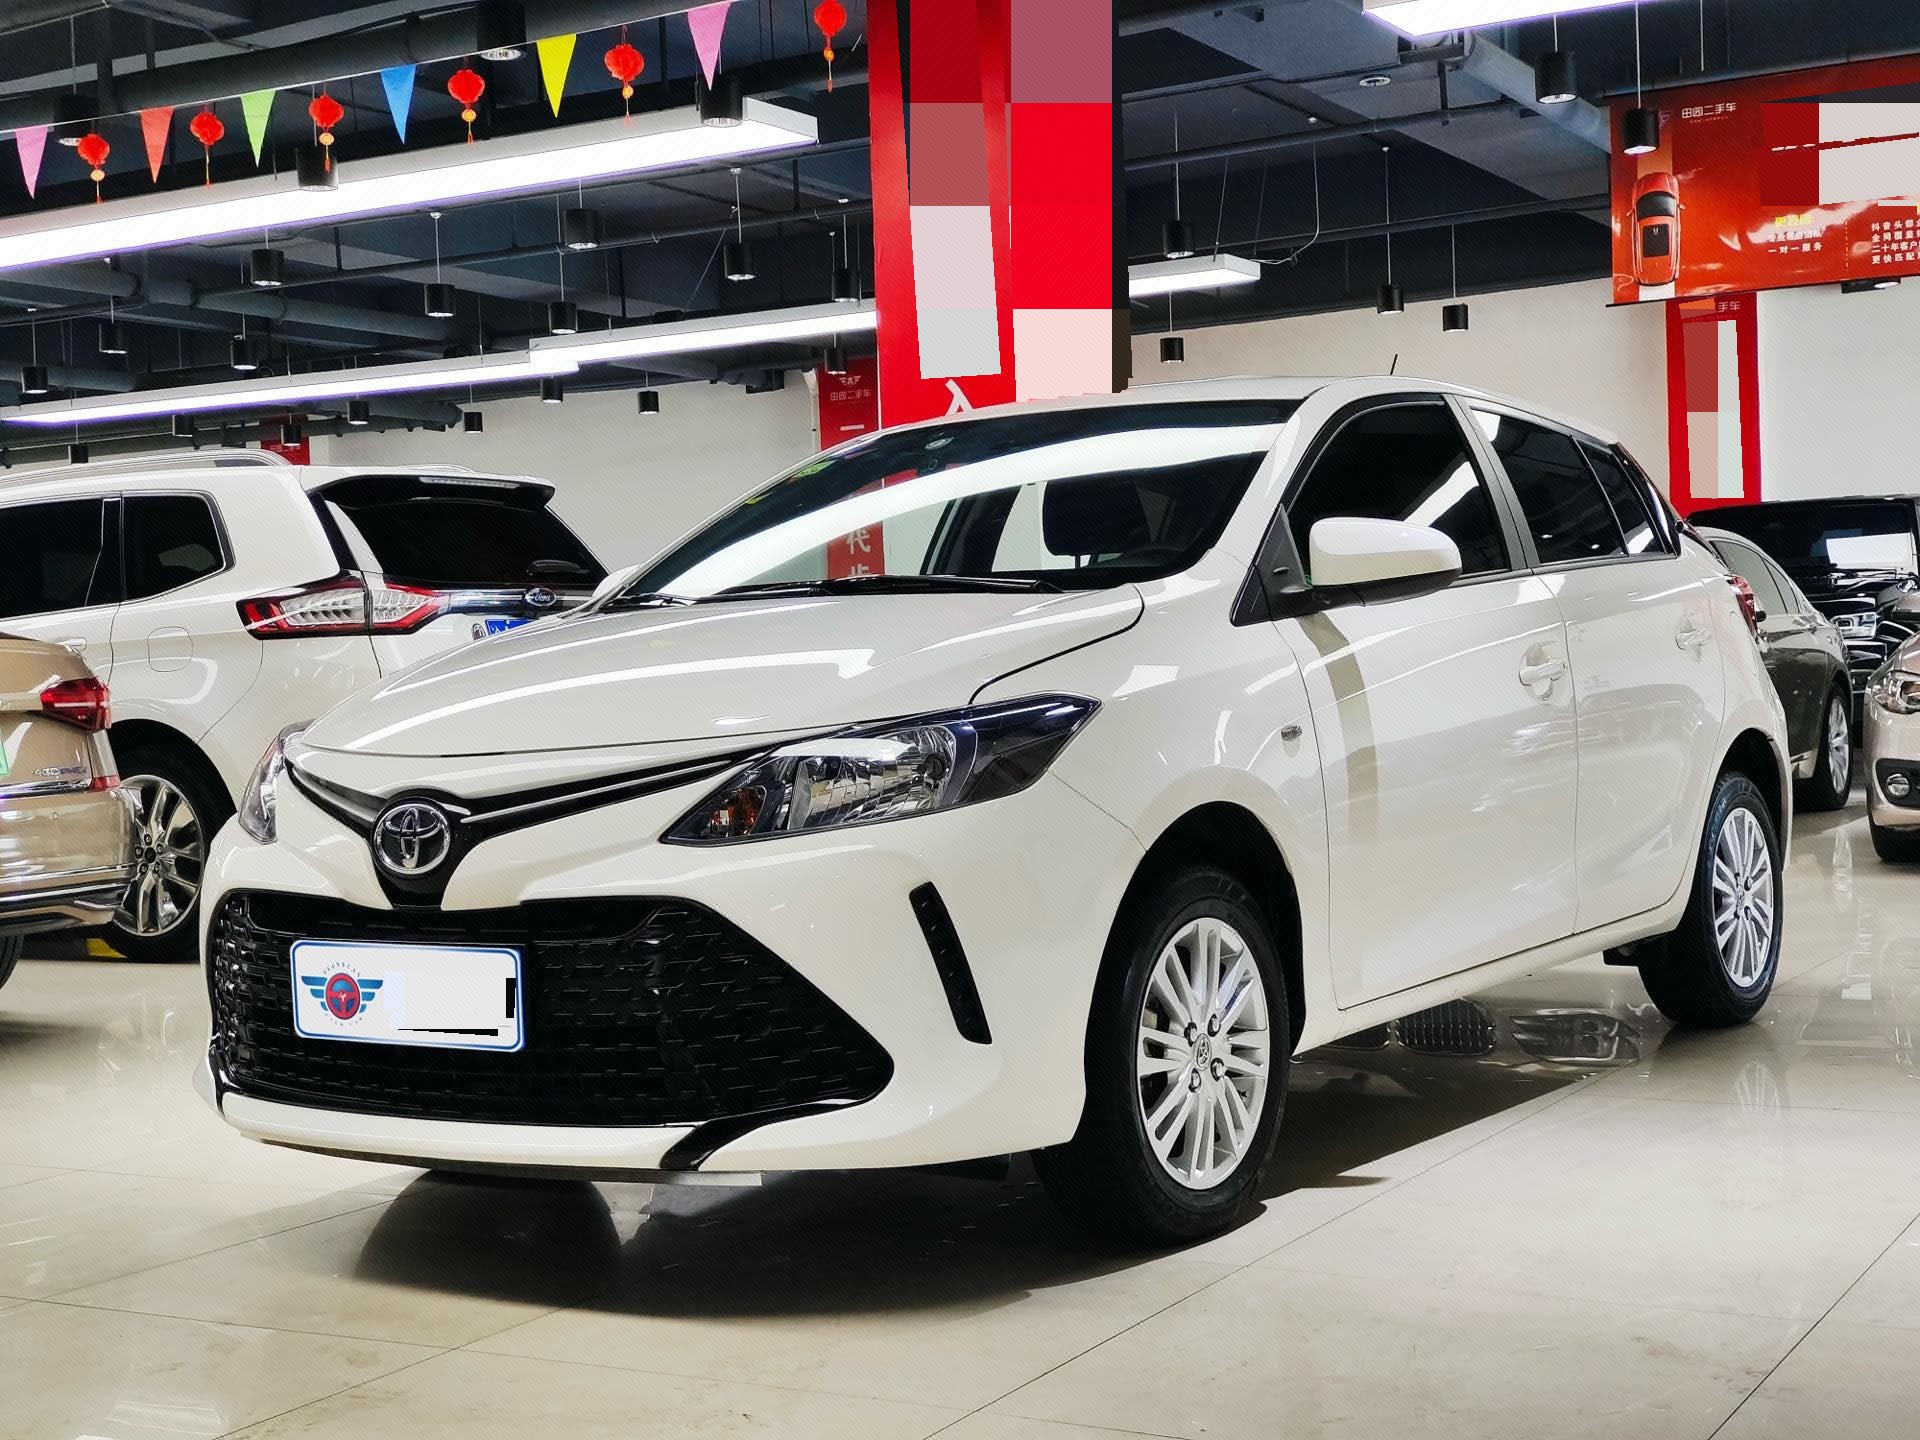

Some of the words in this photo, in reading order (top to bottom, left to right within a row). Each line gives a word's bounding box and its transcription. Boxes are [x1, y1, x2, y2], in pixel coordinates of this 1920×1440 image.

[1681, 102, 1737, 119] 田园二手车
[1768, 242, 1823, 254] 一对一服务
[1871, 241, 1920, 253] 二十年客户
